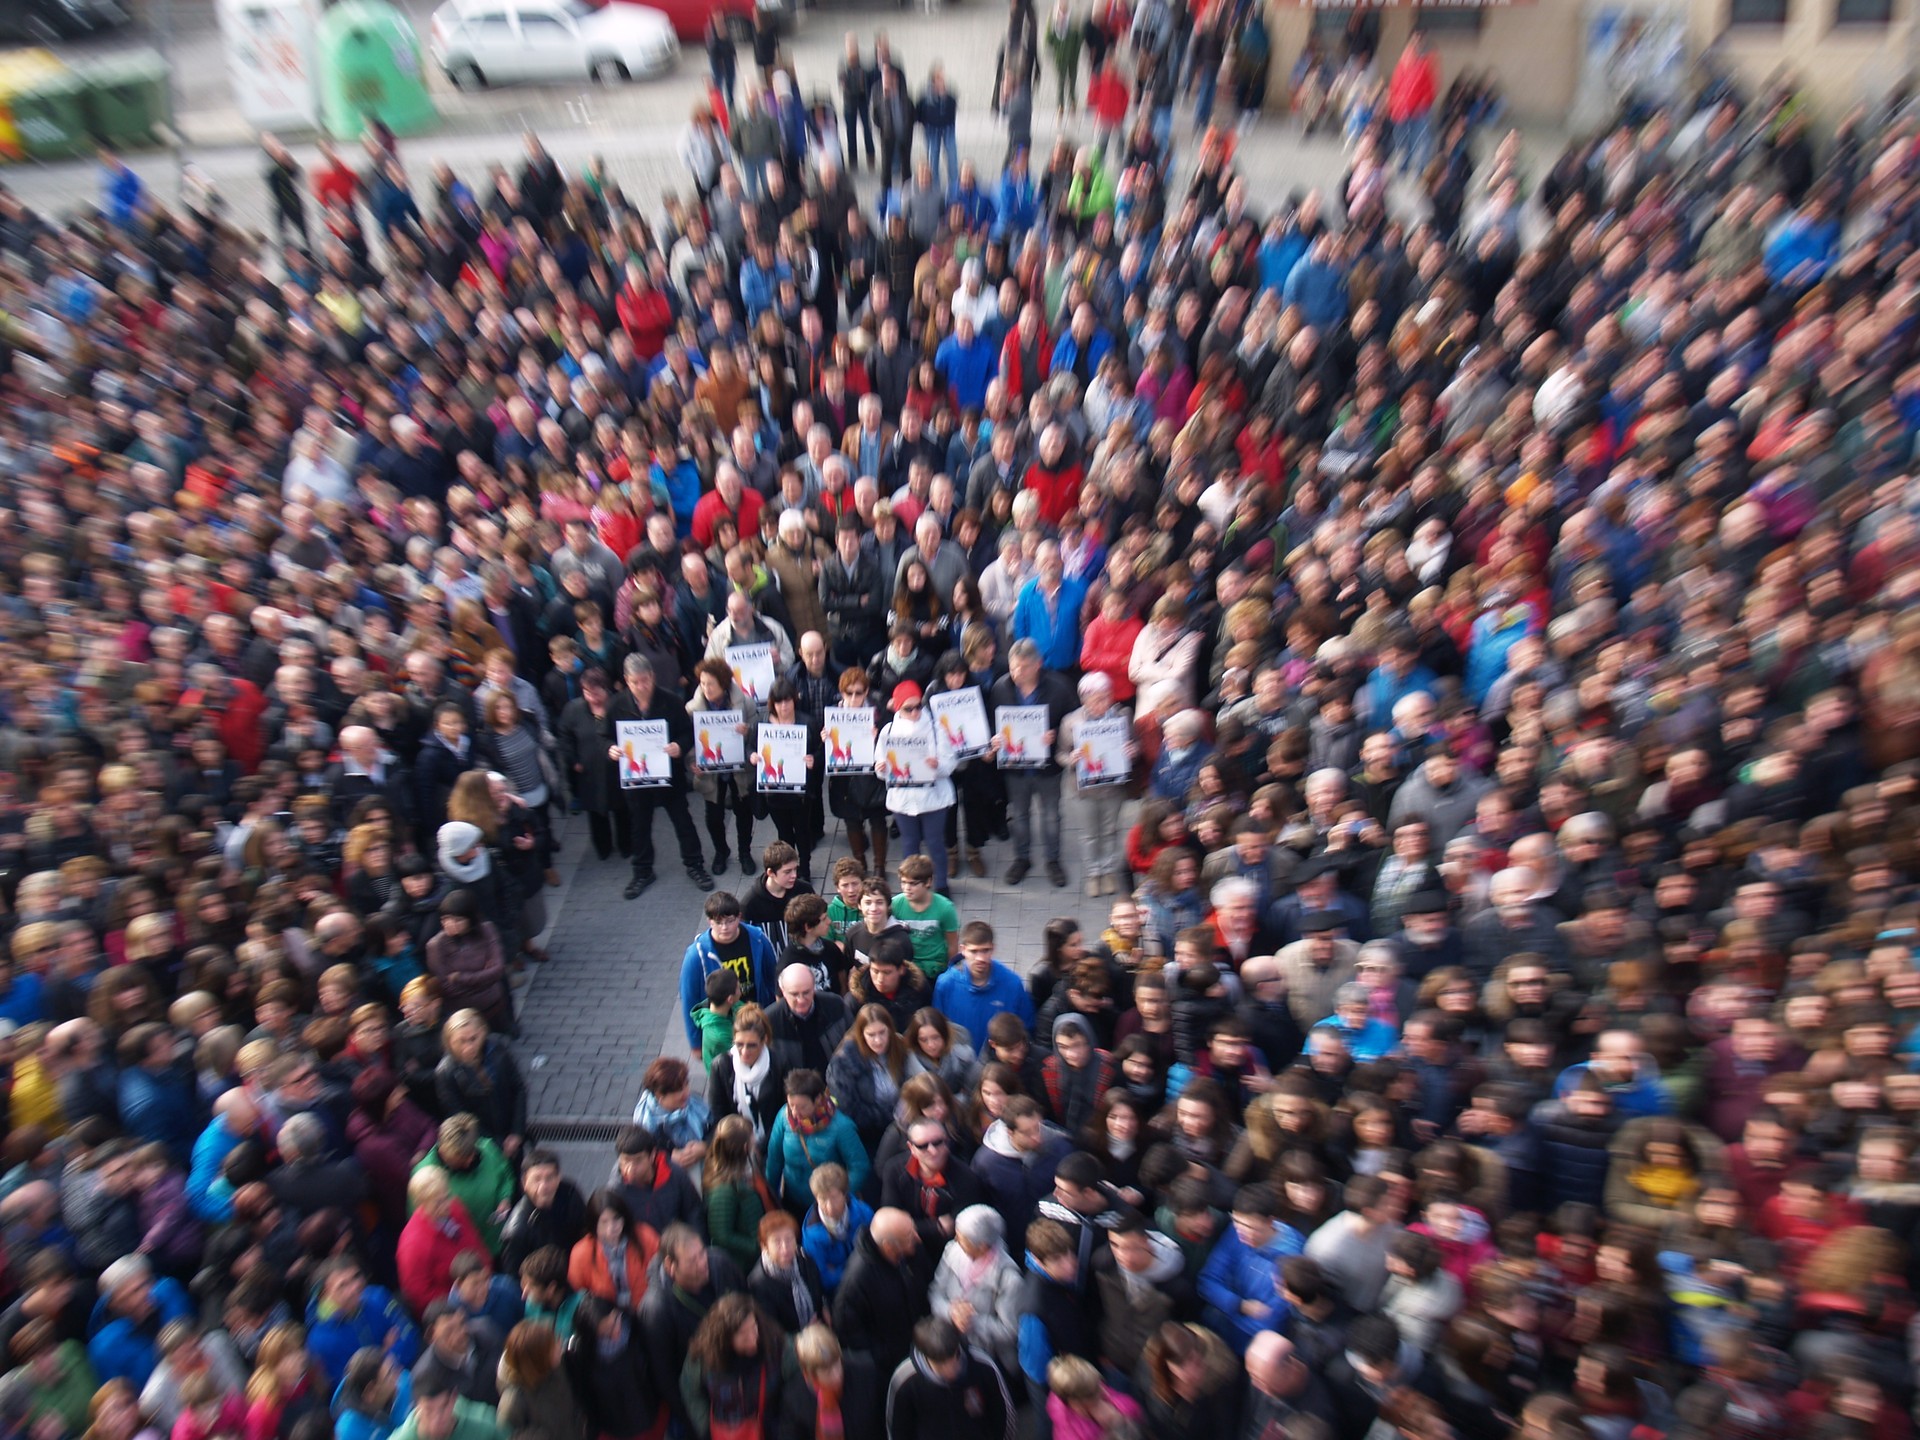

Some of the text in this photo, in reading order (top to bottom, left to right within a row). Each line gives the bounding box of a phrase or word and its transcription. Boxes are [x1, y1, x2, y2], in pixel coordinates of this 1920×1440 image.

[732, 648, 768, 660] ALTSASU
[700, 715, 740, 725] ALTSASU
[831, 713, 870, 722] ALTSASU
[623, 725, 663, 735] ALTSASU
[763, 729, 803, 739] ALTSASU
